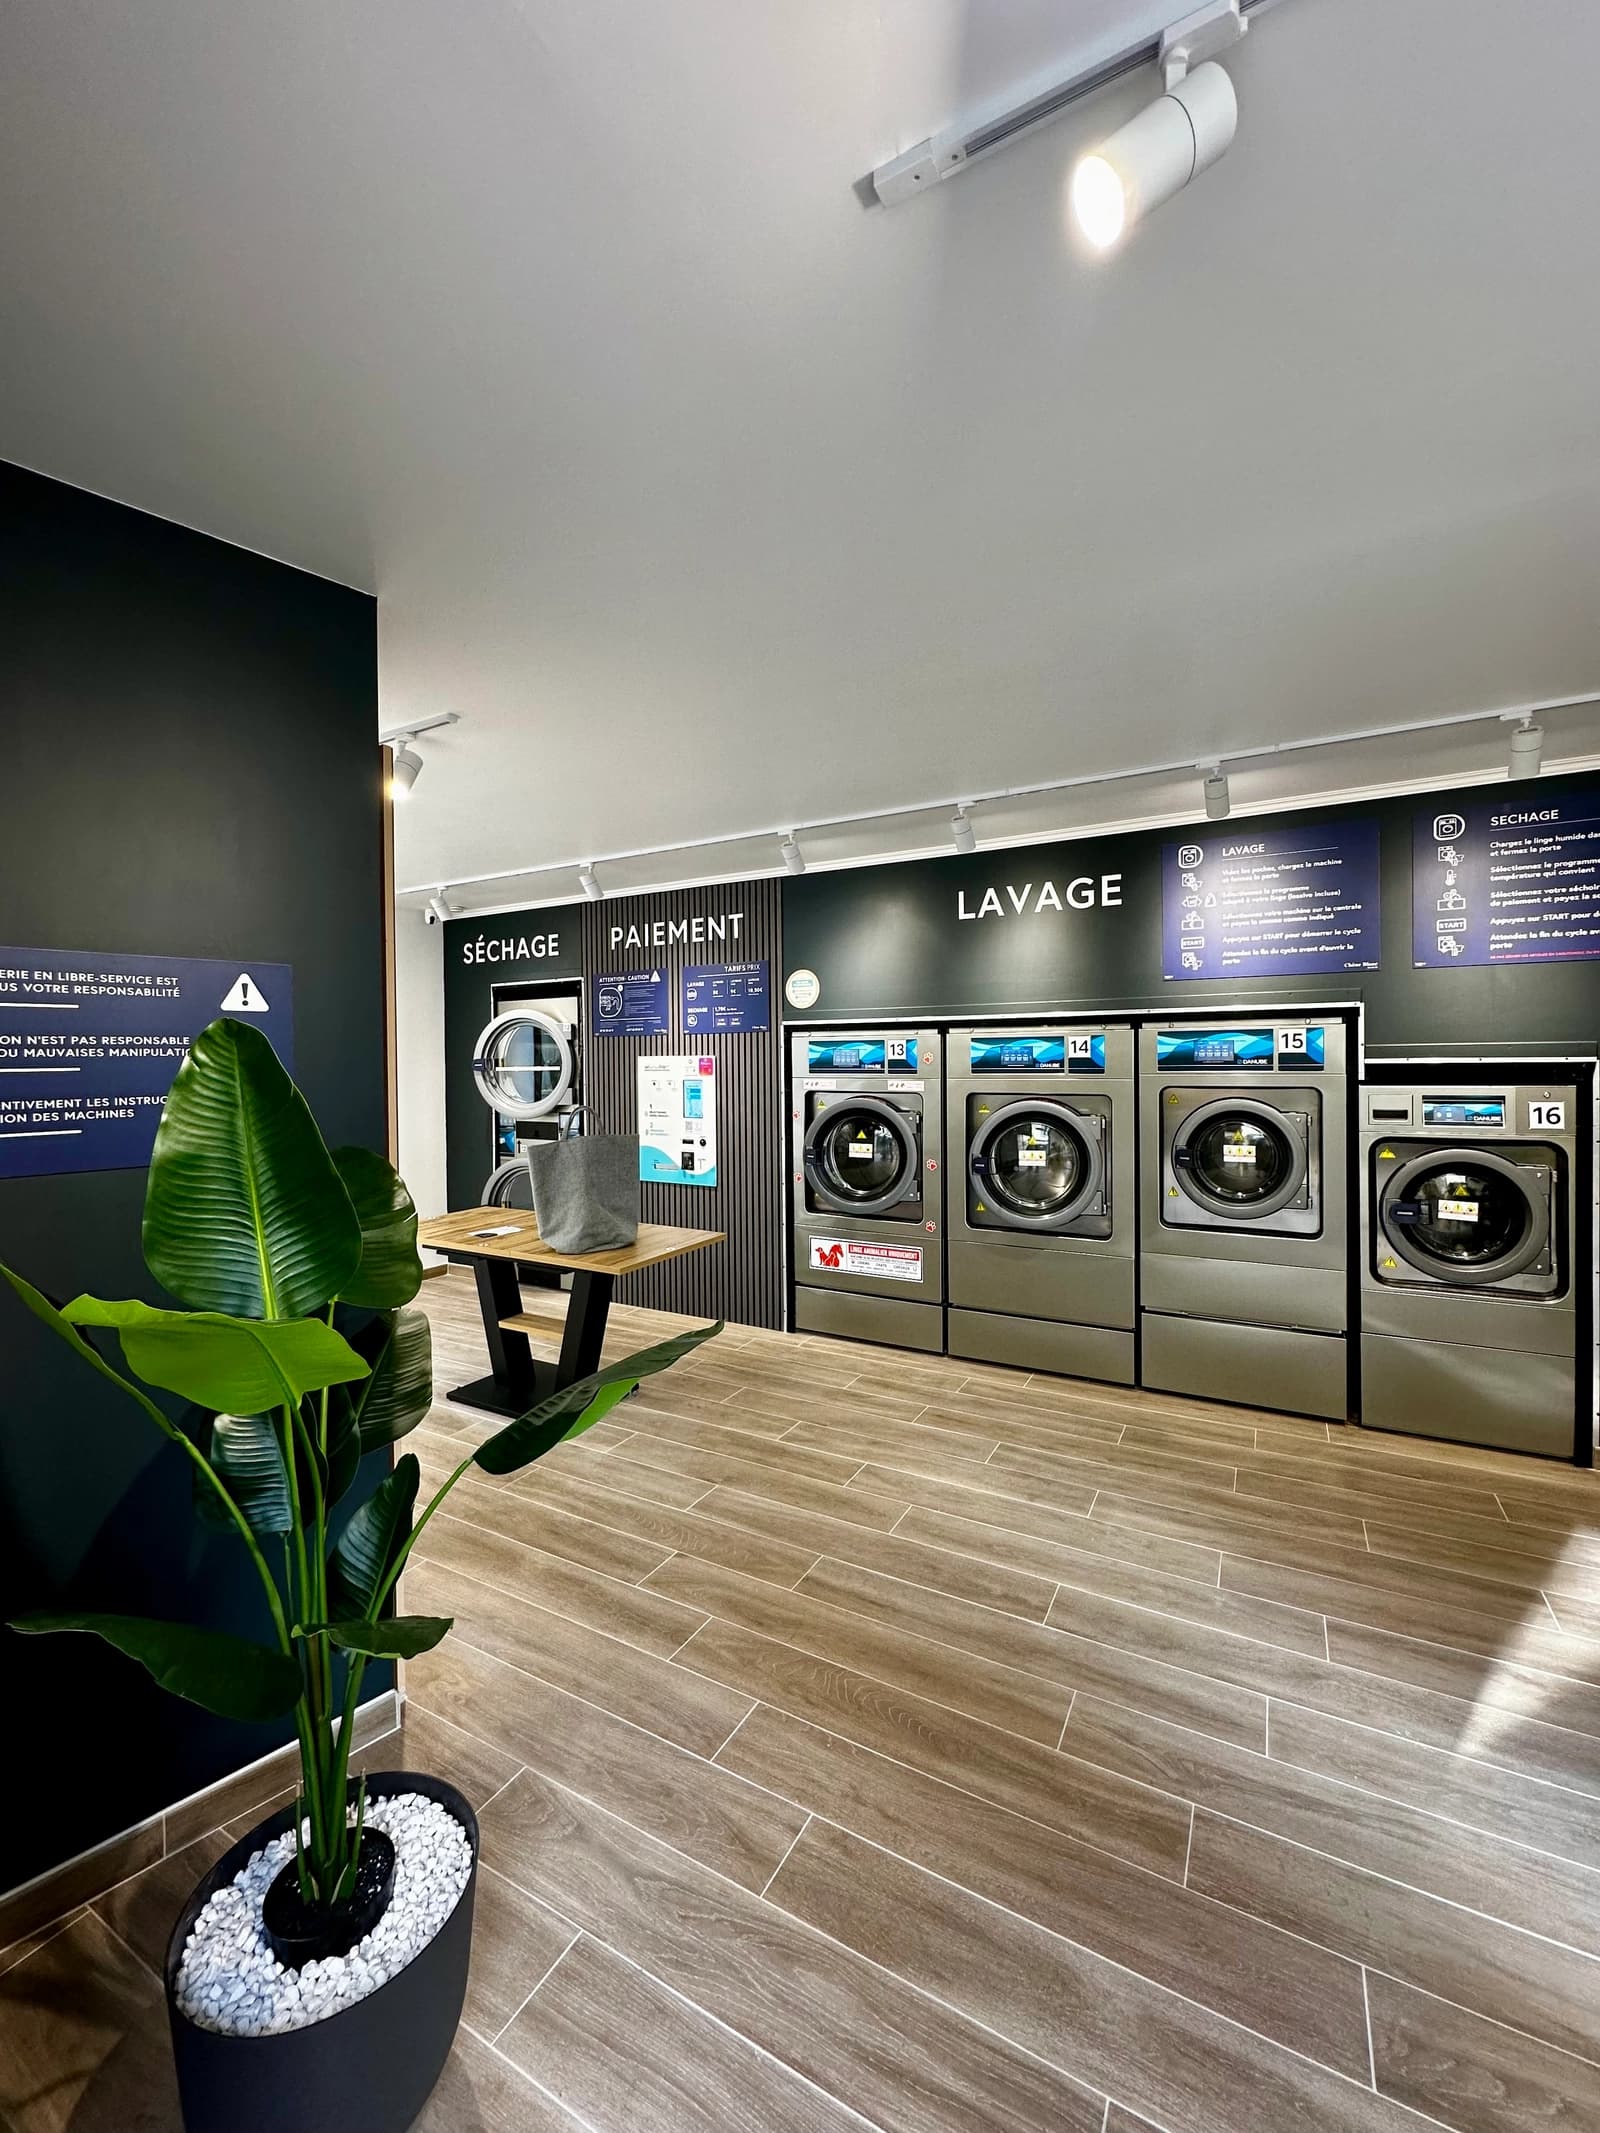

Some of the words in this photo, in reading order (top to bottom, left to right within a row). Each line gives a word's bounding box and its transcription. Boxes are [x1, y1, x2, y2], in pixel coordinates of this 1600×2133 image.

[1490, 809, 1559, 826] SECHAGE
[1490, 840, 1523, 849] Chargez
[1533, 837, 1554, 845] linge
[1555, 834, 1586, 842] humide
[1222, 844, 1265, 856] LAVAGE
[1500, 848, 1529, 856] fermez
[1539, 845, 1562, 853] porte
[1278, 863, 1304, 871] chargez
[1313, 859, 1343, 867] machine
[1490, 864, 1542, 873] Sélectionnez
[1490, 872, 1542, 882] température
[1543, 869, 1557, 878] qui
[1558, 867, 1596, 876] convient
[958, 873, 1123, 920] LAVAGE
[1314, 889, 1341, 898] incluse)
[1490, 890, 1543, 899] Sélectionnez
[1568, 883, 1600, 893] séchoir
[1333, 902, 1362, 911] centrale
[1490, 899, 1501, 907] de
[1502, 897, 1541, 908] paiement
[1553, 895, 1580, 904] payez
[1581, 892, 1590, 900] la
[1439, 921, 1463, 929] START
[1490, 917, 1526, 926] Appuyez
[1542, 912, 1570, 921] START
[1570, 912, 1592, 921] pour
[611, 913, 744, 950] PAIEMENT
[1262, 932, 1284, 940] START
[1284, 931, 1301, 940] pour
[1301, 929, 1333, 938] démarrer
[1342, 927, 1362, 936] cycle
[1490, 932, 1529, 941] Attendez
[1529, 931, 1538, 939] la
[1538, 930, 1551, 938] fin
[1564, 928, 1588, 938] cycle
[463, 934, 560, 964] SÉCHAGE
[1280, 946, 1298, 955] cycle
[1299, 945, 1318, 953] avant
[1319, 943, 1346, 952] d'ouvrir
[1490, 942, 1513, 951] porte
[724, 964, 746, 973] TARIFS
[34, 971, 53, 981] EN
[58, 972, 153, 985] LIBRE-SERVICE
[156, 977, 179, 986] EST
[23, 983, 70, 994] VOTRE
[73, 985, 181, 998] RESPONSABILITÉ
[0, 1035, 21, 1045] ON
[27, 1036, 66, 1045] N'EST
[71, 1036, 97, 1045] PAS
[101, 1036, 190, 1045] RESPONSABLE
[1070, 1040, 1089, 1053] 14
[1281, 1033, 1304, 1049] 15
[24, 1048, 105, 1058] MAUVAISES
[890, 1043, 905, 1056] 13
[86, 1097, 110, 1107] LES
[32, 1112, 60, 1122] DES
[64, 1109, 135, 1120] MACHINES
[1533, 1107, 1561, 1125] 16
